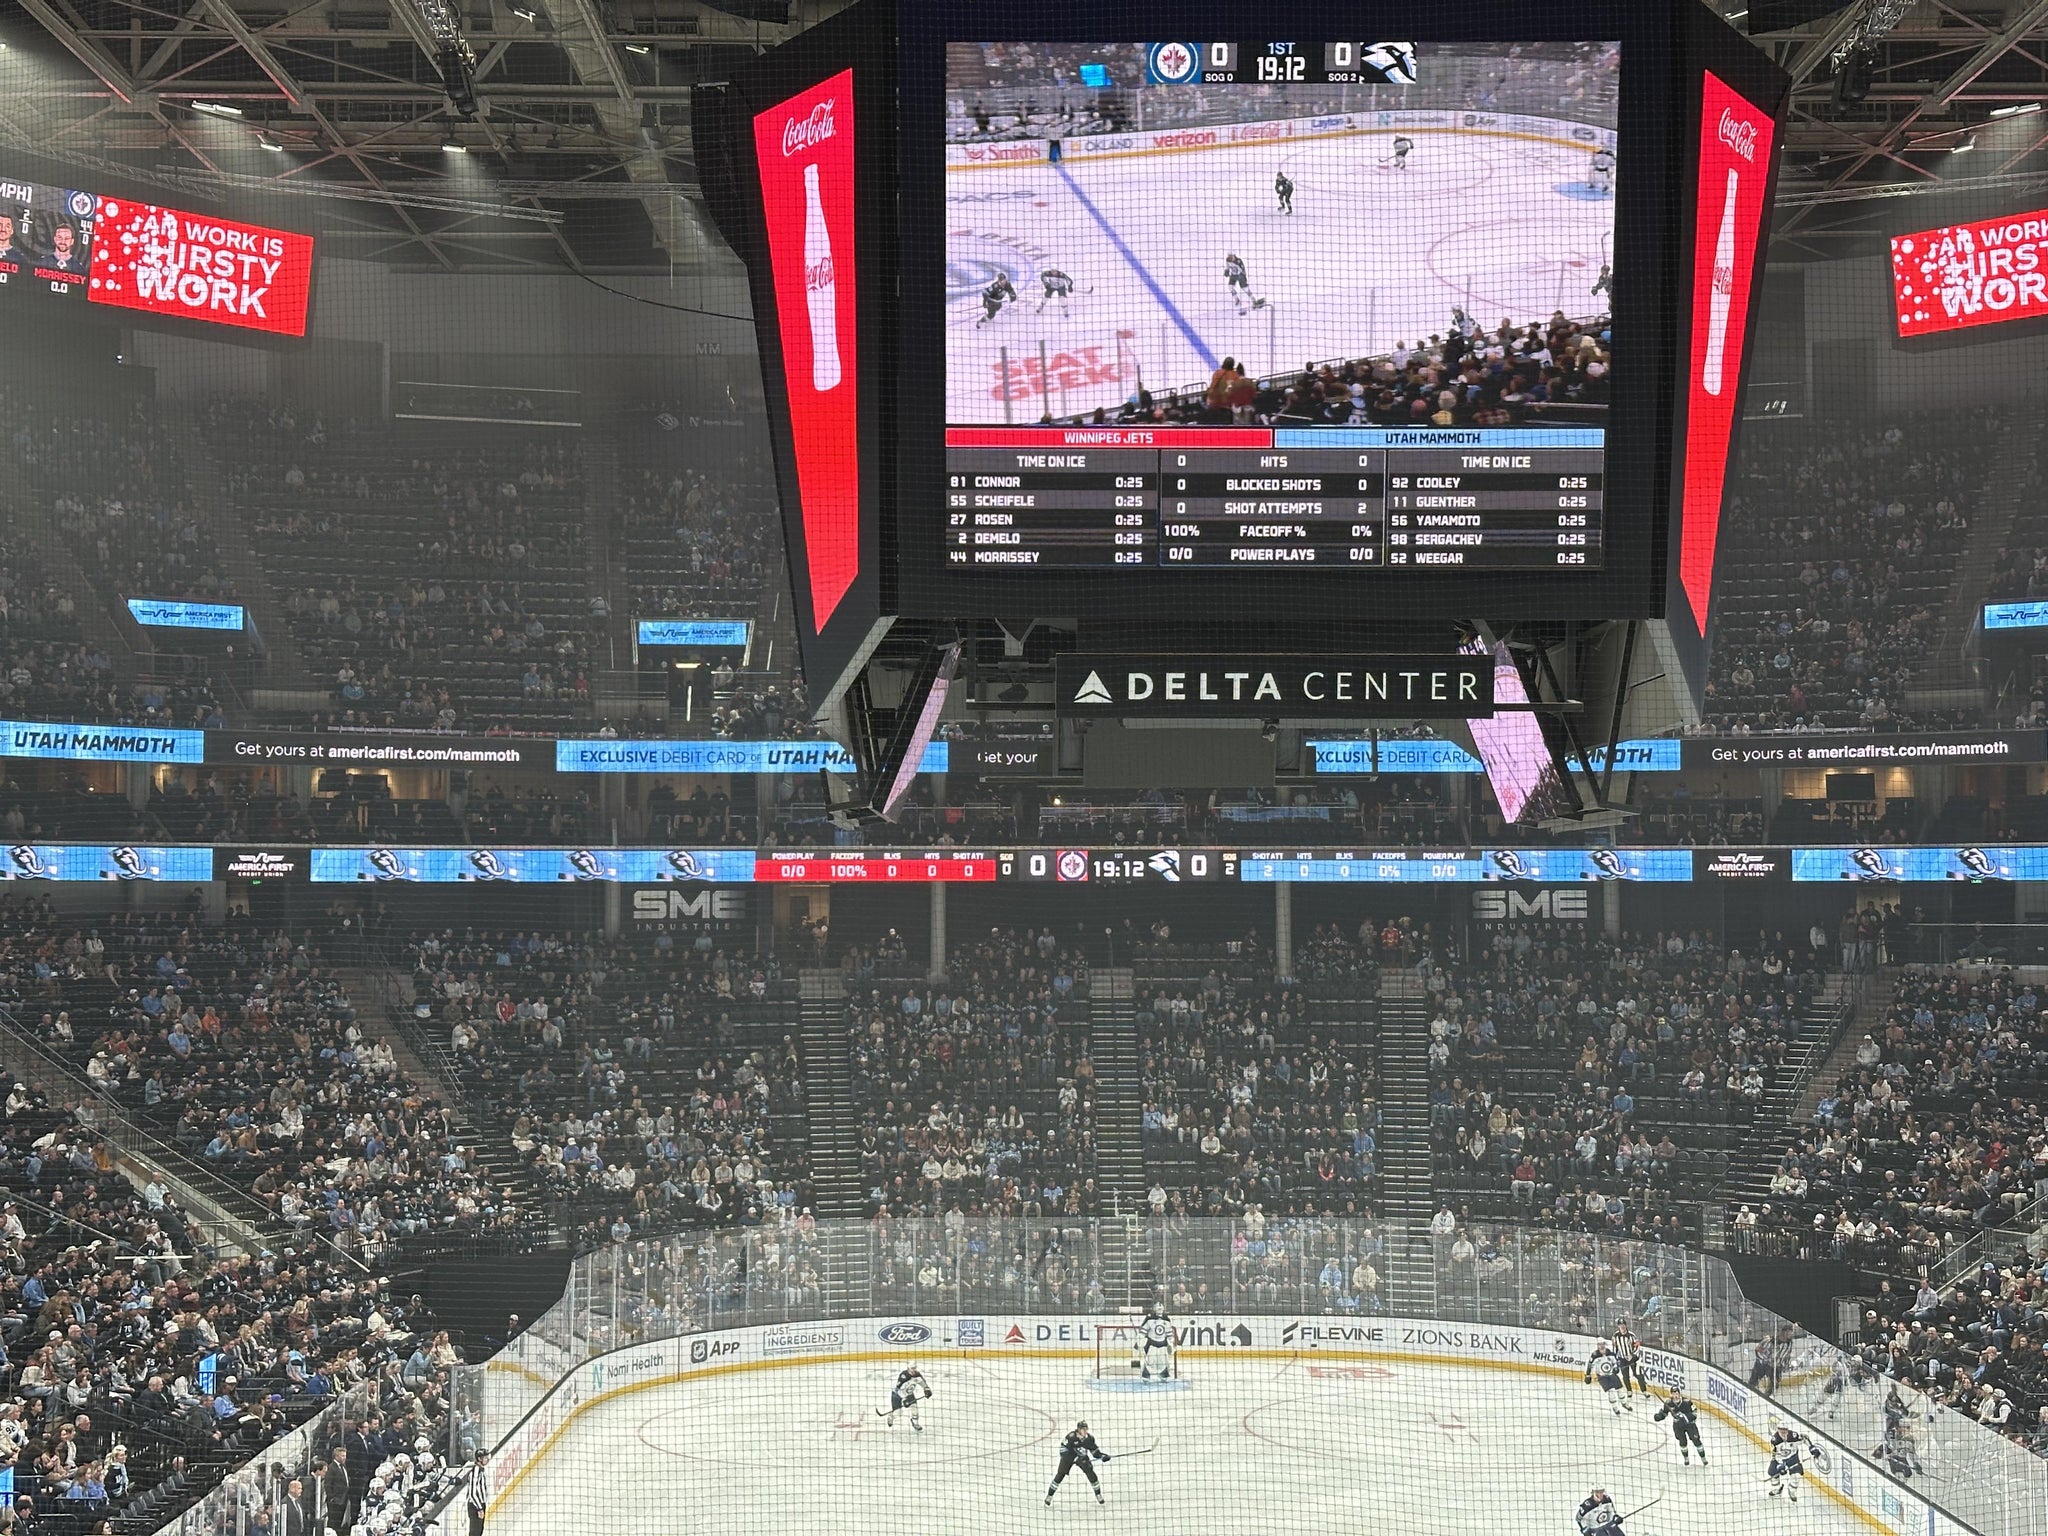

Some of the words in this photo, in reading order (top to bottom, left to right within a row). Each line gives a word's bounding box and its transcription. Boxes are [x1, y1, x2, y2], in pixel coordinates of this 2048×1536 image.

[1211, 42, 1228, 67] 0
[1268, 42, 1295, 55] 1ST
[1335, 42, 1350, 66] 0
[1256, 56, 1306, 81] 19:12
[1205, 73, 1225, 82] SOG
[1226, 73, 1233, 82] 0
[1328, 73, 1348, 82] SOG
[1349, 73, 1356, 82] 2
[782, 96, 836, 157] Coca-Cola
[1153, 130, 1217, 147] verizon
[1718, 107, 1758, 164] Coca-Cola
[23, 209, 30, 220] 2
[21, 223, 29, 234] 0
[80, 219, 93, 231] 44
[82, 234, 89, 245] 0
[185, 220, 257, 253] WORK
[263, 236, 284, 257] IS
[34, 267, 86, 285] MORRISSEY
[50, 281, 68, 294] 0.0
[1064, 432, 1121, 444] WINNIPEG
[1123, 432, 1154, 444] JETS
[1385, 433, 1418, 444] UTAH
[1419, 433, 1480, 444] MAMMOTH
[1016, 456, 1046, 468] TIME
[1048, 456, 1064, 467] ON
[1066, 456, 1086, 467] ICE
[1177, 455, 1186, 467] 0
[1260, 456, 1288, 468] HITS
[1358, 455, 1367, 467] 0
[1461, 456, 1490, 468] TIME
[1492, 456, 1508, 468] ON
[1511, 456, 1531, 468] ICE
[950, 477, 966, 488] 81
[975, 477, 1020, 488] CONNOR
[1115, 477, 1143, 488] 0:25
[1177, 479, 1186, 491] 0
[1226, 479, 1279, 491] BLOCKED
[1281, 479, 1321, 491] SHOTS
[1358, 479, 1367, 491] 0
[1392, 478, 1408, 488] 92
[1416, 478, 1460, 489] COOLEY
[1559, 478, 1587, 489] 0:25
[950, 496, 966, 506] 55
[975, 496, 1035, 507] SCHEIFELE
[1115, 496, 1143, 507] 0:25
[1393, 497, 1408, 507] 11
[1416, 496, 1476, 508] GUENTHER
[1559, 496, 1587, 508] 0:25
[1177, 502, 1186, 514] 0
[1224, 502, 1256, 515] SHOT
[1257, 502, 1322, 515] ATTEMPTS
[1357, 503, 1367, 514] 2
[950, 514, 966, 525] 27
[975, 515, 1013, 526] ROSEN
[1114, 515, 1143, 526] 0:25
[1391, 515, 1407, 526] 56
[1416, 515, 1480, 527] YAMAMOTO
[1558, 515, 1586, 527] 0:25
[1164, 525, 1200, 537] 100%
[1239, 525, 1291, 538] FACEOFF
[1294, 526, 1306, 537] %
[1351, 526, 1372, 537] 0%
[958, 533, 967, 545] 2
[975, 533, 1021, 545] DEMELO
[1114, 534, 1143, 545] 0:25
[1391, 534, 1407, 545] 98
[1415, 534, 1482, 546] SERGACHEV
[1557, 534, 1586, 546] 0:25
[950, 552, 967, 563] 44
[975, 552, 1040, 564] MORRISSEY
[1114, 552, 1143, 564] 0:25
[1169, 548, 1193, 560] 0/0
[1230, 548, 1272, 561] POWER
[1274, 548, 1315, 561] PLAYS
[1350, 548, 1373, 560] 0/0
[1390, 553, 1407, 564] 52
[1415, 553, 1464, 564] WEEGAR
[1557, 553, 1585, 564] 0:25
[1127, 672, 1281, 701] DELTA
[1303, 671, 1478, 701] CENTER
[14, 731, 68, 750] UTAH
[71, 734, 176, 754] MAMMOTH
[235, 742, 261, 756] Get
[266, 744, 305, 759] yours
[310, 745, 324, 757] at
[328, 746, 520, 762] americafirst.com/mammoth
[580, 750, 657, 764] EXCLUSIVE
[661, 751, 702, 764] DEBIT
[706, 751, 746, 764] CARD
[751, 753, 762, 763] OF
[768, 750, 819, 765] UTAH
[1388, 751, 1429, 763] DEBIT
[1433, 751, 1472, 763] CARD
[1711, 747, 1738, 761] Get
[1742, 748, 1784, 762] yours
[1787, 746, 1803, 759] at
[1807, 741, 2008, 760] americafirst.com/mammoth
[227, 863, 268, 871] AMERICA
[268, 863, 294, 871] FIRST
[781, 865, 805, 877] 0/0
[830, 865, 867, 877] 100%
[888, 865, 897, 877] 0
[928, 865, 936, 877] 0
[964, 865, 973, 877] 0
[1002, 863, 1011, 875] 0
[1030, 855, 1046, 876] 0
[1093, 861, 1145, 877] 19:12
[1191, 855, 1207, 876] 0
[1225, 863, 1234, 875] 2
[1264, 865, 1273, 877] 2
[1300, 865, 1309, 877] 0
[1340, 865, 1349, 877] 0
[1379, 865, 1399, 877] 0%
[1432, 865, 1456, 877] 0/0
[1707, 863, 1748, 872] AMERICA
[1748, 863, 1775, 872] FIRST
[633, 890, 747, 919] SME
[1472, 889, 1588, 919] SME
[636, 923, 741, 931] INDUSTRIE
[767, 1326, 790, 1336] JUST
[888, 1326, 922, 1341] Ford
[1300, 1327, 1384, 1342] FILEVINE
[768, 1332, 839, 1347] INGREDIENTS
[1402, 1328, 1463, 1348] ZIONS
[1470, 1334, 1503, 1354] BANK
[607, 1362, 630, 1380] Nomi
[631, 1353, 664, 1374] Health
[1708, 1376, 1728, 1402] BUD
[1726, 1386, 1747, 1416] LIGHT
